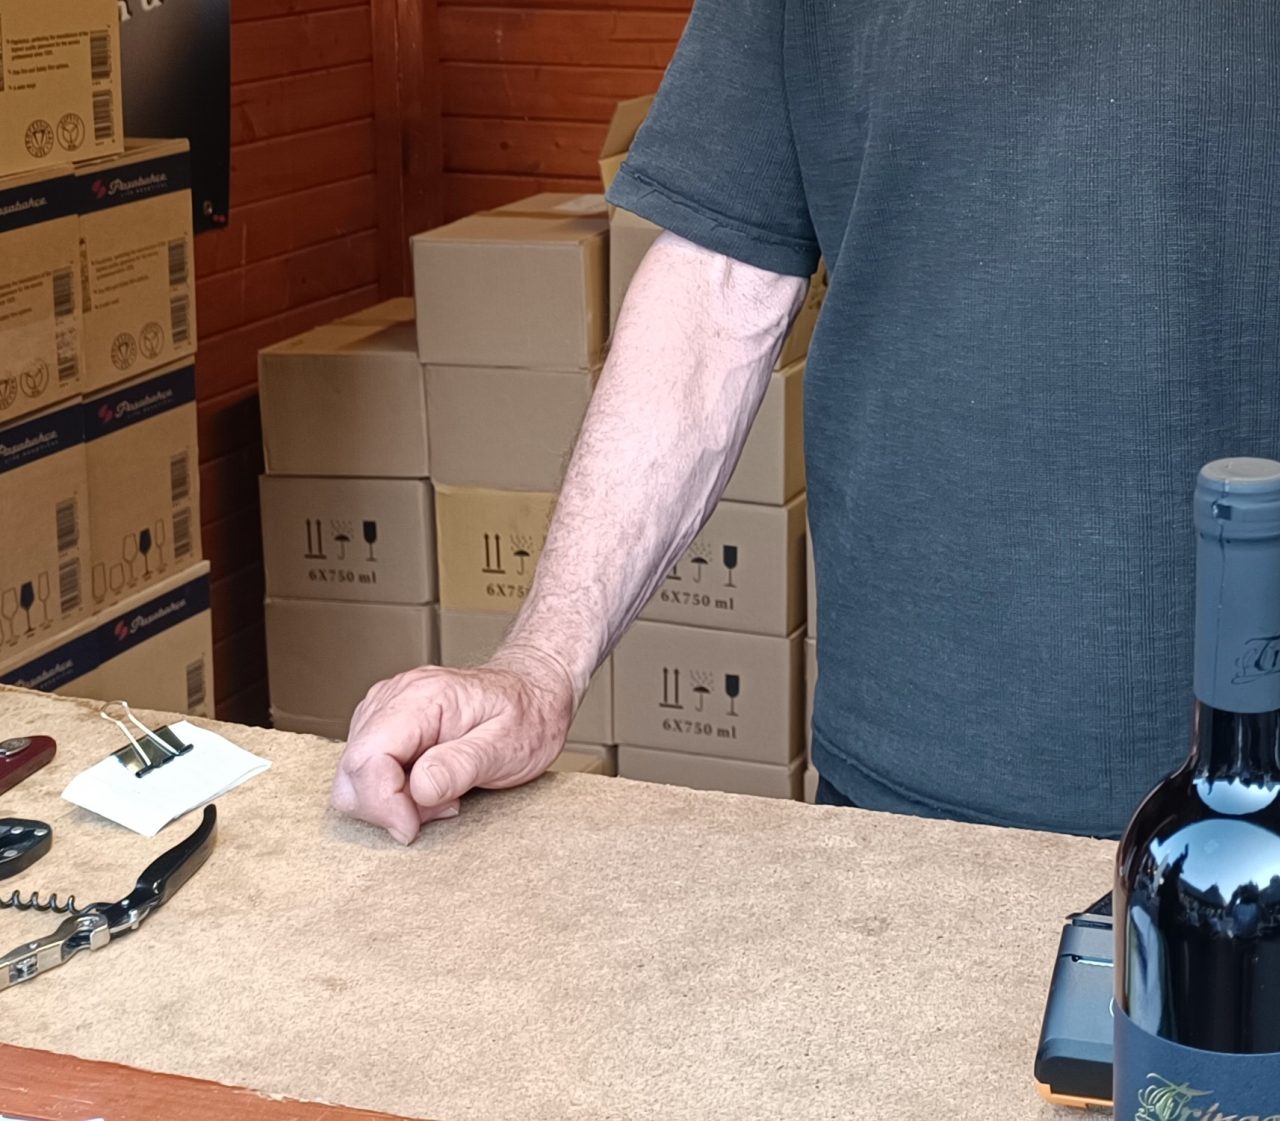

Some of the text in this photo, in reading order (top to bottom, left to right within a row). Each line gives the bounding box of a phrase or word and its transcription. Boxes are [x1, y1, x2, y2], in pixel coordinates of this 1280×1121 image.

[486, 582, 530, 599] 6X75
[660, 590, 735, 611] 6X750 ml
[662, 718, 737, 739] 6X750 ml
